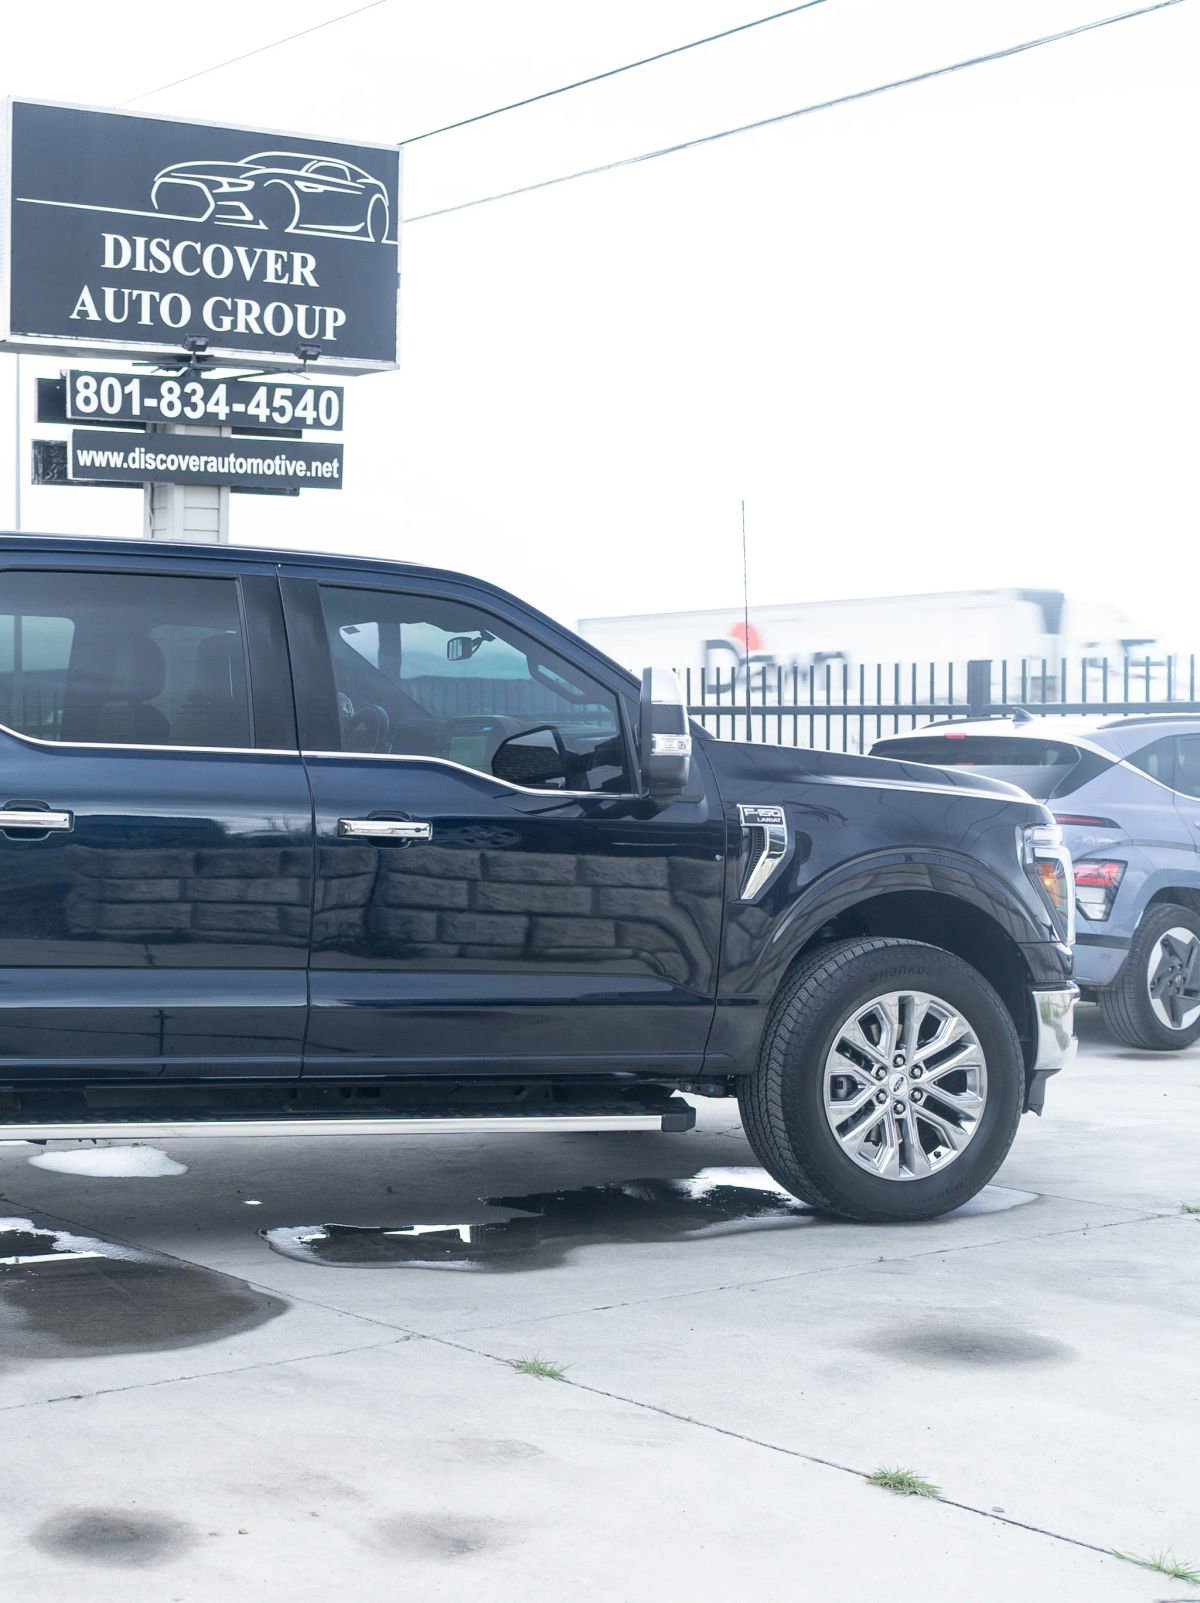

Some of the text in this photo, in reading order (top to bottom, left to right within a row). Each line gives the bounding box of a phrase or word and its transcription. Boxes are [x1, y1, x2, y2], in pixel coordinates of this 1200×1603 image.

[101, 233, 320, 287] DISCOVER
[69, 285, 347, 341] AUTO GROUP
[75, 375, 340, 426] 801-834-4540
[76, 447, 340, 478] www.discoverautomotive.net
[743, 808, 782, 817] F-150
